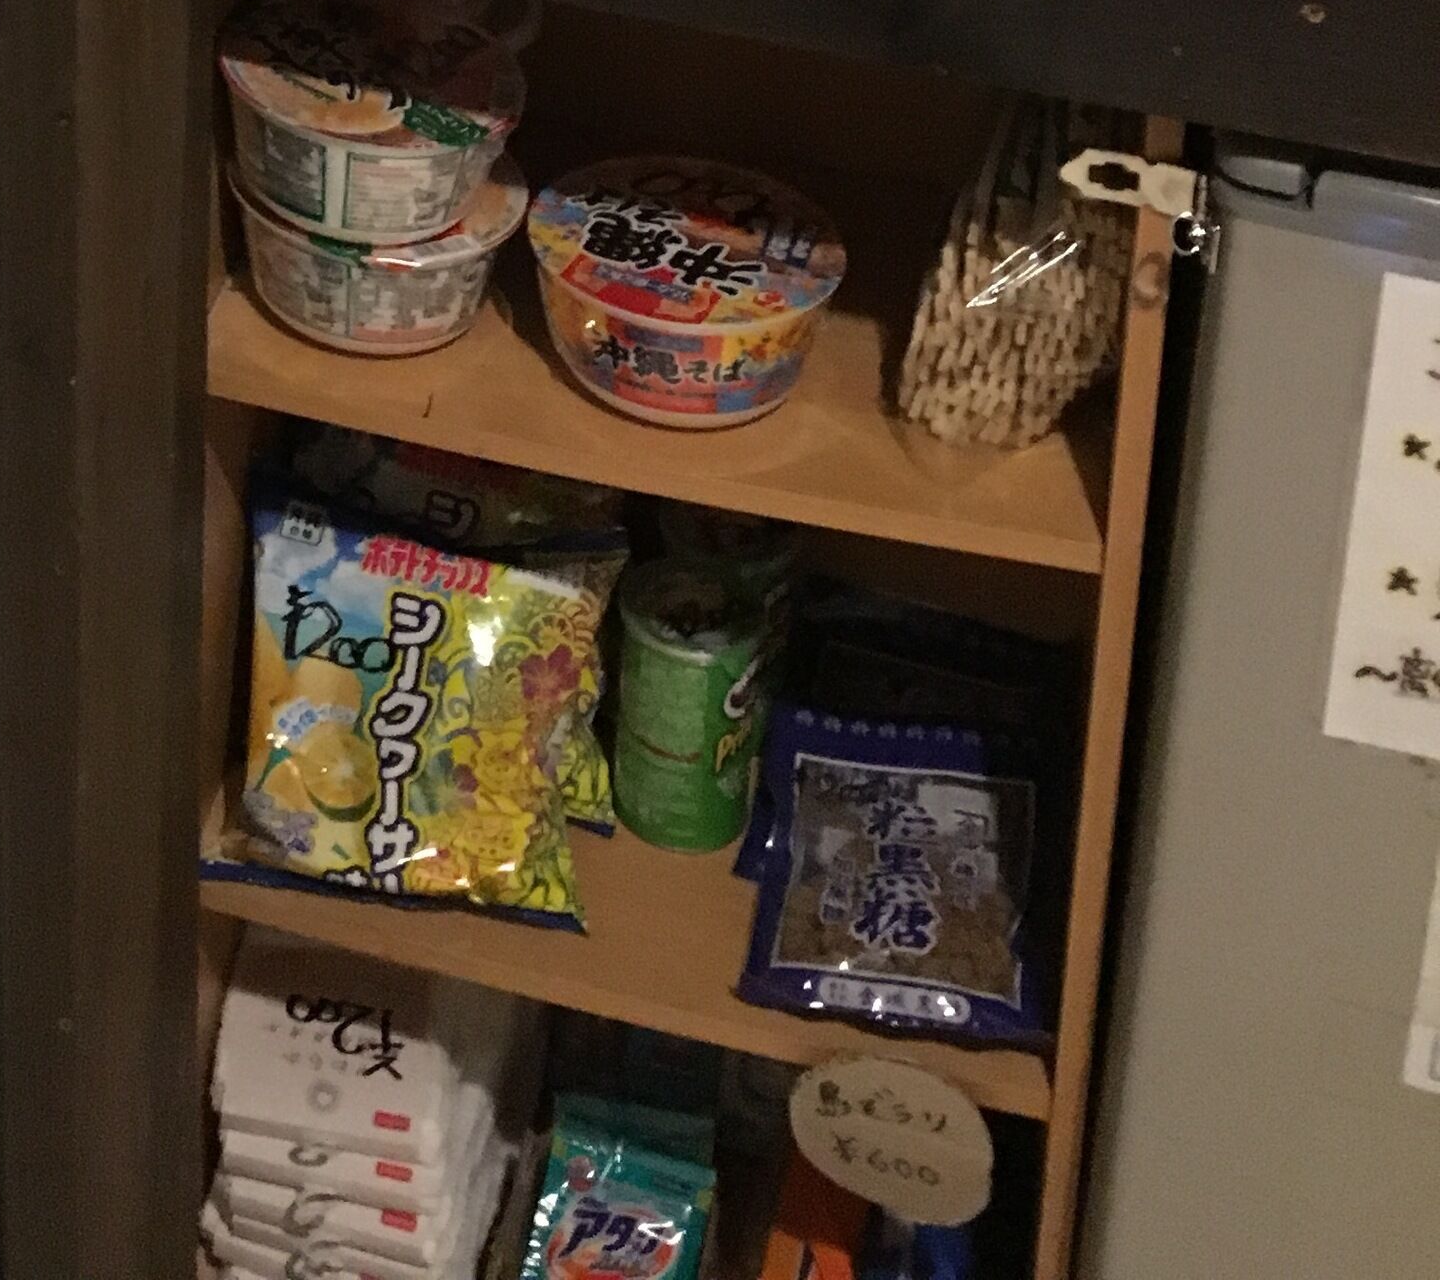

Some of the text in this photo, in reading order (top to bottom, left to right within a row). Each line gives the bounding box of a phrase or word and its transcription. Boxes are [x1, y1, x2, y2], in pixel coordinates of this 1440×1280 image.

[593, 334, 748, 385] 沖縄そば
[361, 536, 492, 597] ポテトチップス
